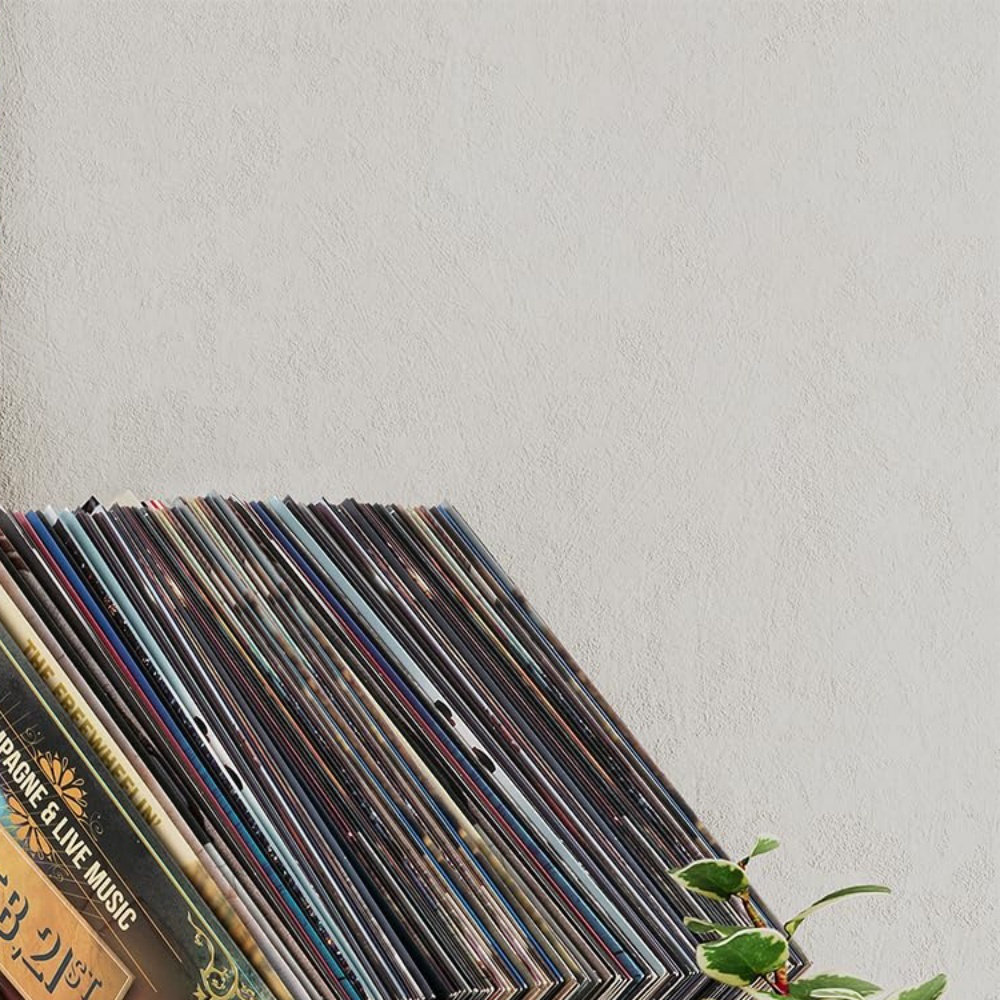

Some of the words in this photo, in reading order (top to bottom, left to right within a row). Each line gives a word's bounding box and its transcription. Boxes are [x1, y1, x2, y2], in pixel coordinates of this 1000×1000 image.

[24, 638, 56, 681] THE
[40, 801, 61, 827] &
[52, 816, 93, 870] LIVE
[83, 859, 137, 932] MUSIC
